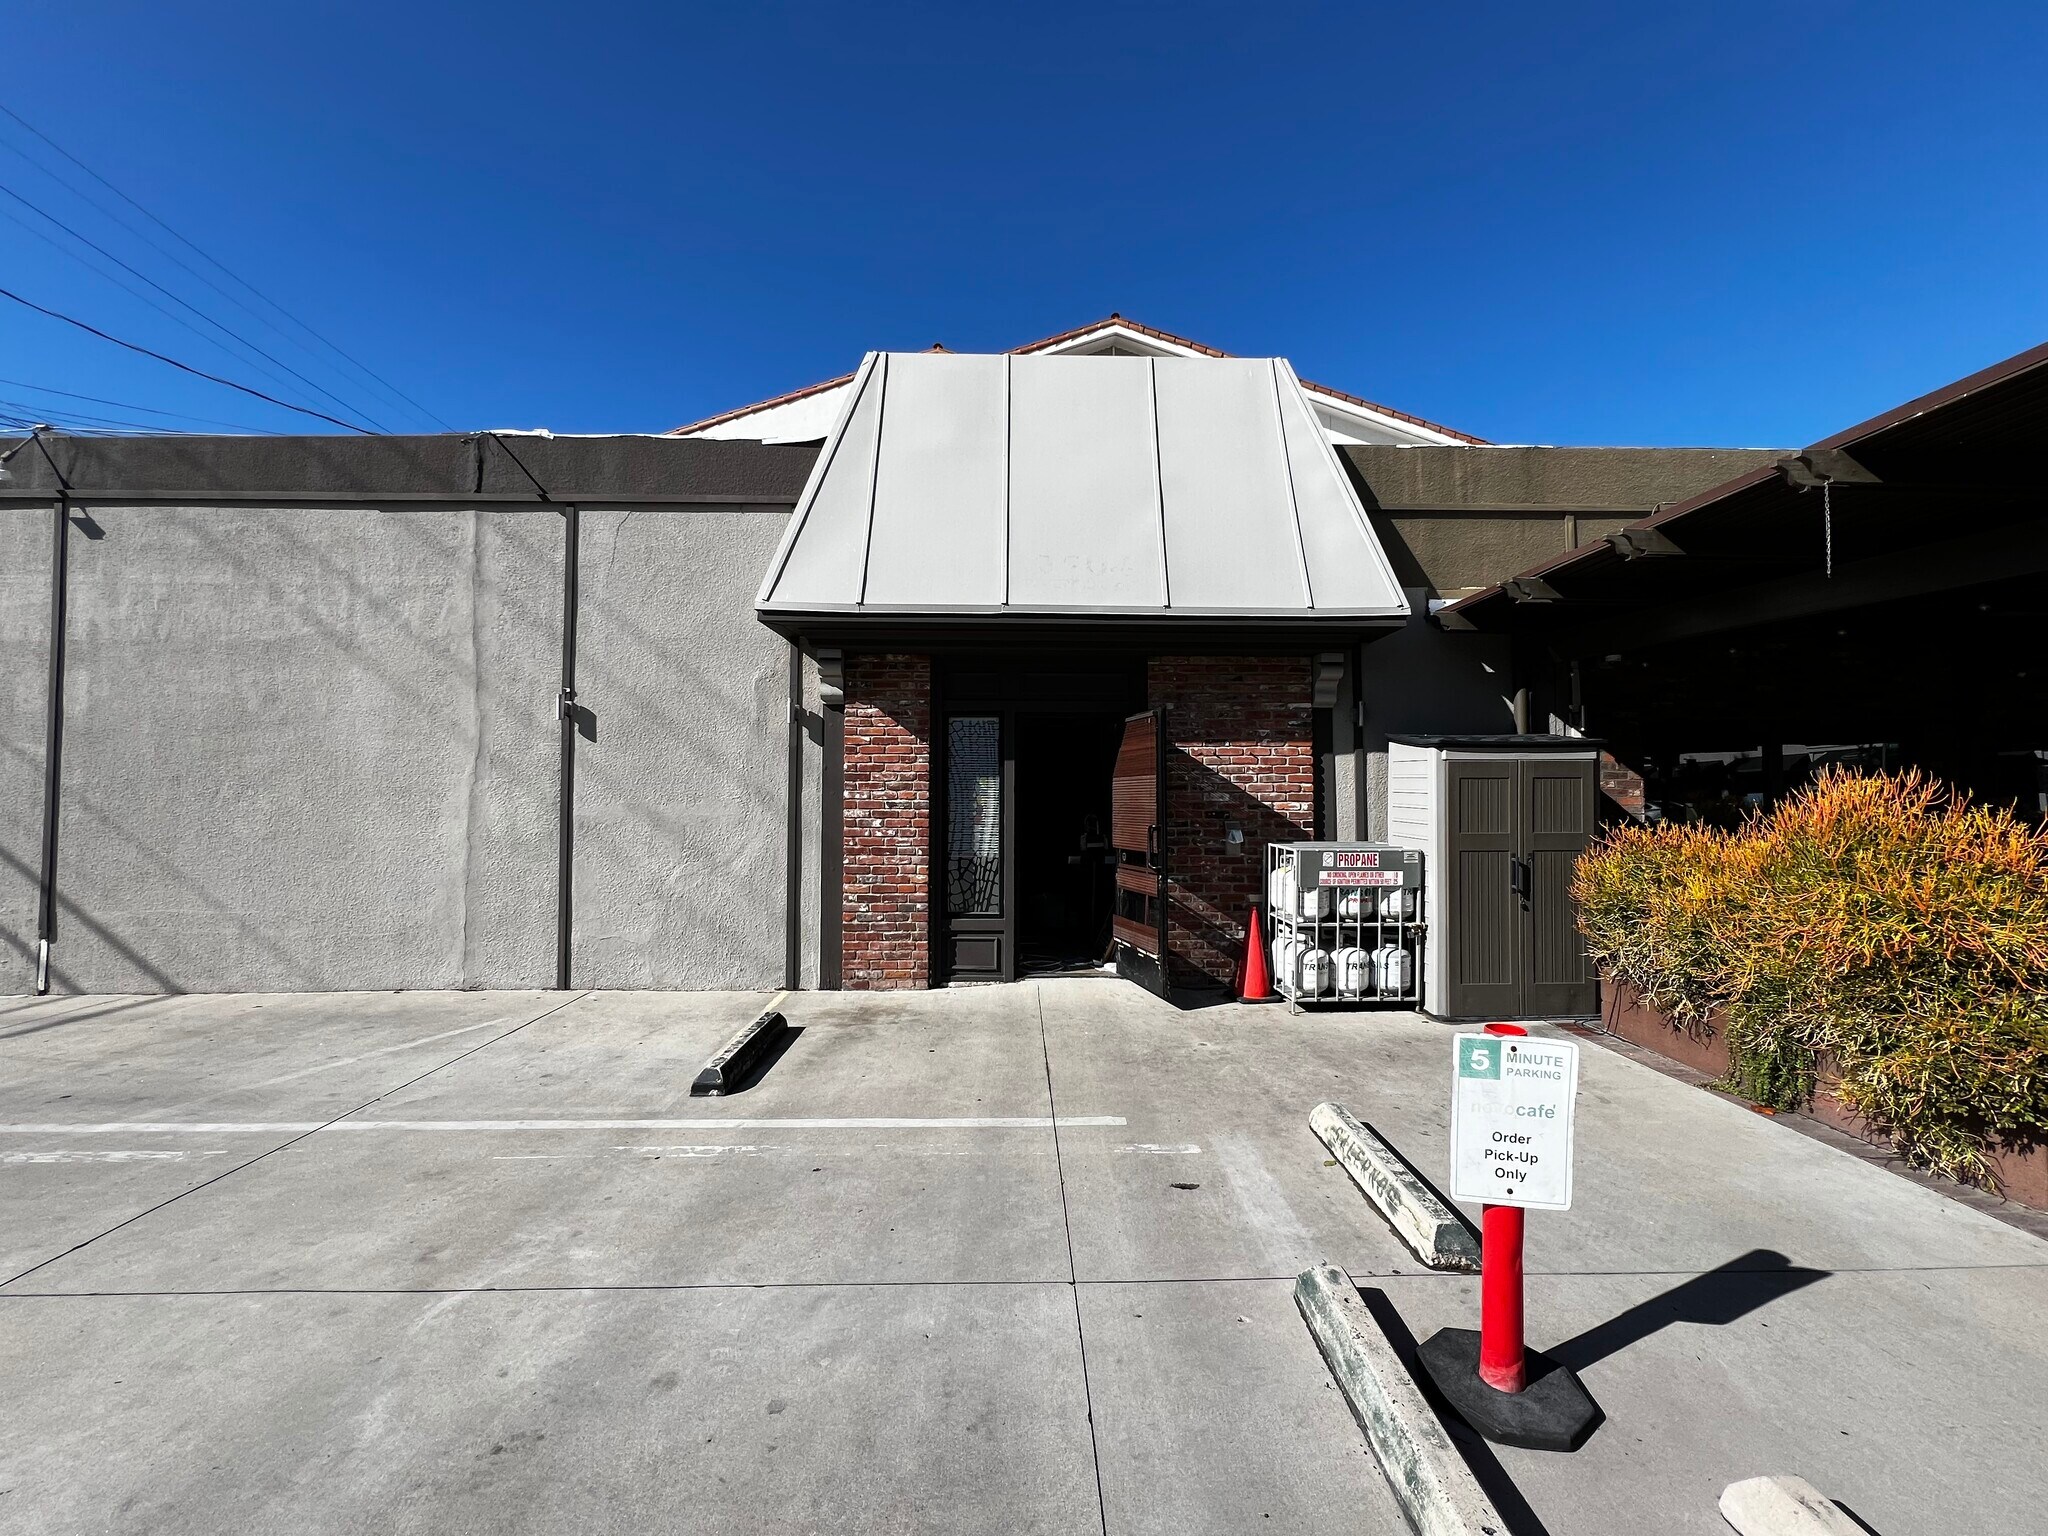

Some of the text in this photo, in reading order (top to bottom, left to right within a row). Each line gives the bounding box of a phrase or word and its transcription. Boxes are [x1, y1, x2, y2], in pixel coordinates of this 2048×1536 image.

[1338, 853, 1377, 866] PROPANE
[1470, 1049, 1490, 1071] 5
[1506, 1052, 1564, 1068] MINUTE
[1506, 1067, 1562, 1081] PARKING
[1492, 1131, 1532, 1145] Order
[1484, 1149, 1539, 1165] Pick-Up
[1494, 1167, 1527, 1183] Only
